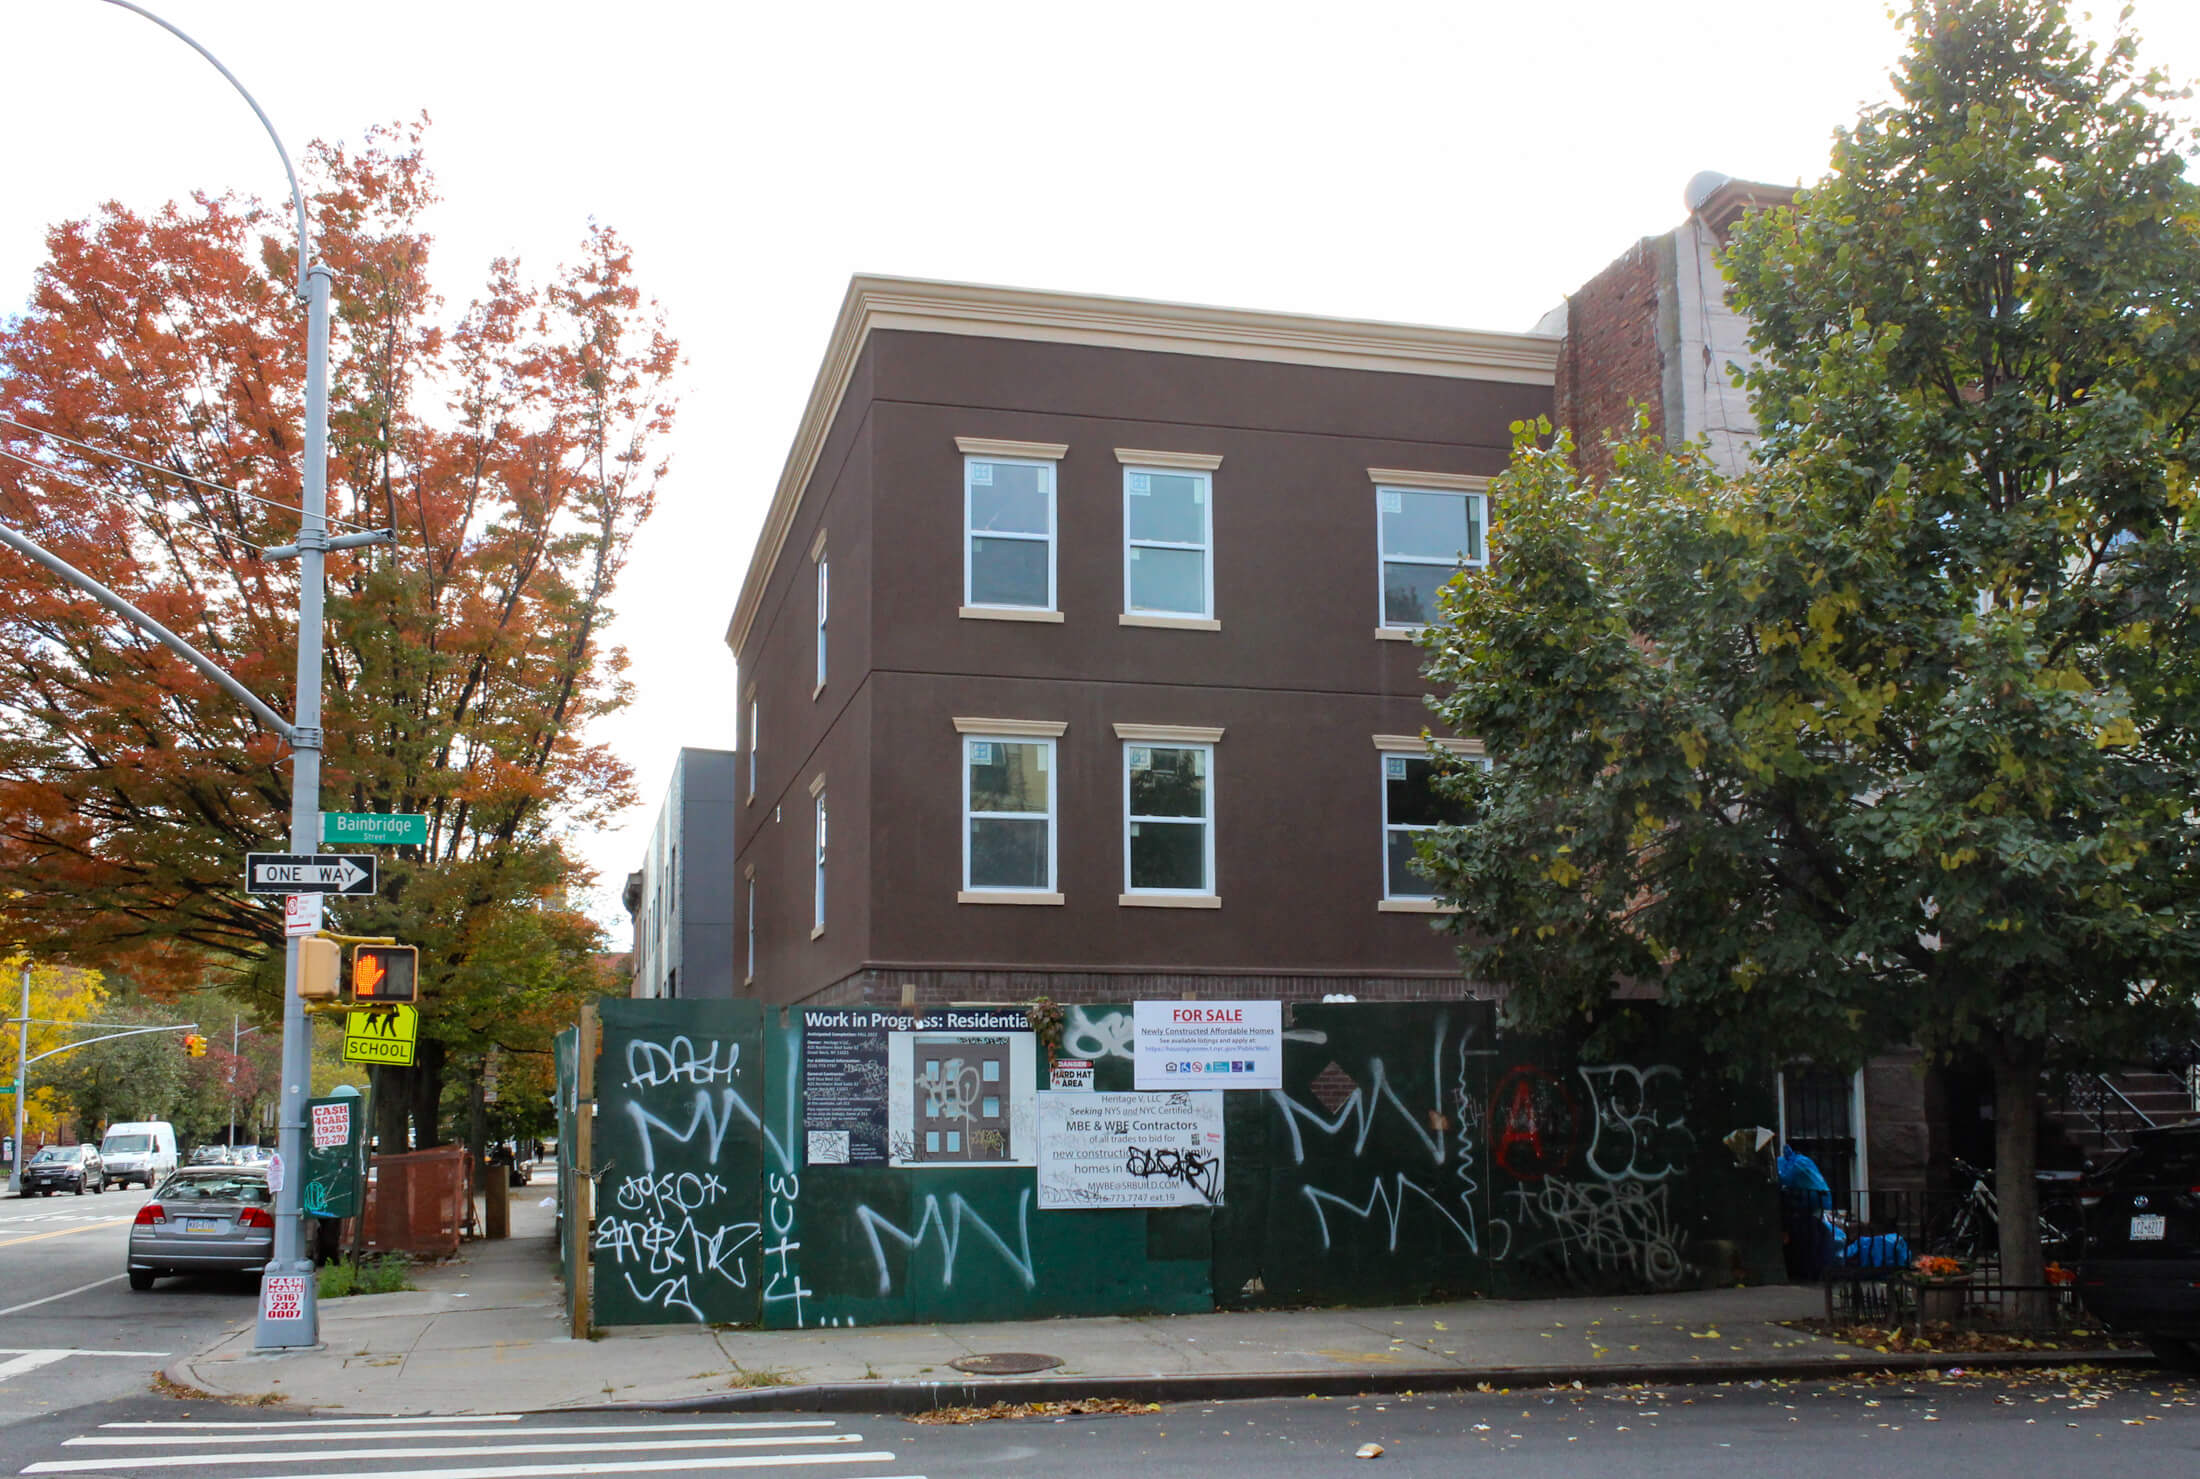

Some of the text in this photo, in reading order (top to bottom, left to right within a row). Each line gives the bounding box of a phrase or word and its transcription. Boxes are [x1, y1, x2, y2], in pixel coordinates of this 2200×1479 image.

[337, 816, 412, 836] Bainbridge
[266, 867, 356, 881] ONE WAY
[1173, 1009, 1243, 1021] FOR SALE
[805, 1012, 1033, 1030] Work in Progrss: Residentia
[1141, 1028, 1163, 1036] Newly
[350, 1042, 408, 1057] SCHOOL
[1101, 1095, 1137, 1103] Heritage
[314, 1105, 347, 1116] CASH
[1070, 1105, 1193, 1116] Seeking NYS and NYC Certified
[315, 1114, 348, 1125] 4CARS
[317, 1124, 347, 1135] (929)
[1066, 1120, 1198, 1131] MBE & WBE Contractors
[1089, 1135, 1098, 1143] of
[1101, 1135, 1110, 1143] all
[1111, 1135, 1137, 1143] trades
[1149, 1135, 1162, 1143] bid
[1164, 1135, 1176, 1143] for
[1074, 1163, 1110, 1173] homes
[1112, 1163, 1122, 1172] in
[272, 1302, 297, 1310] 232
[268, 1310, 301, 1318] 0007
